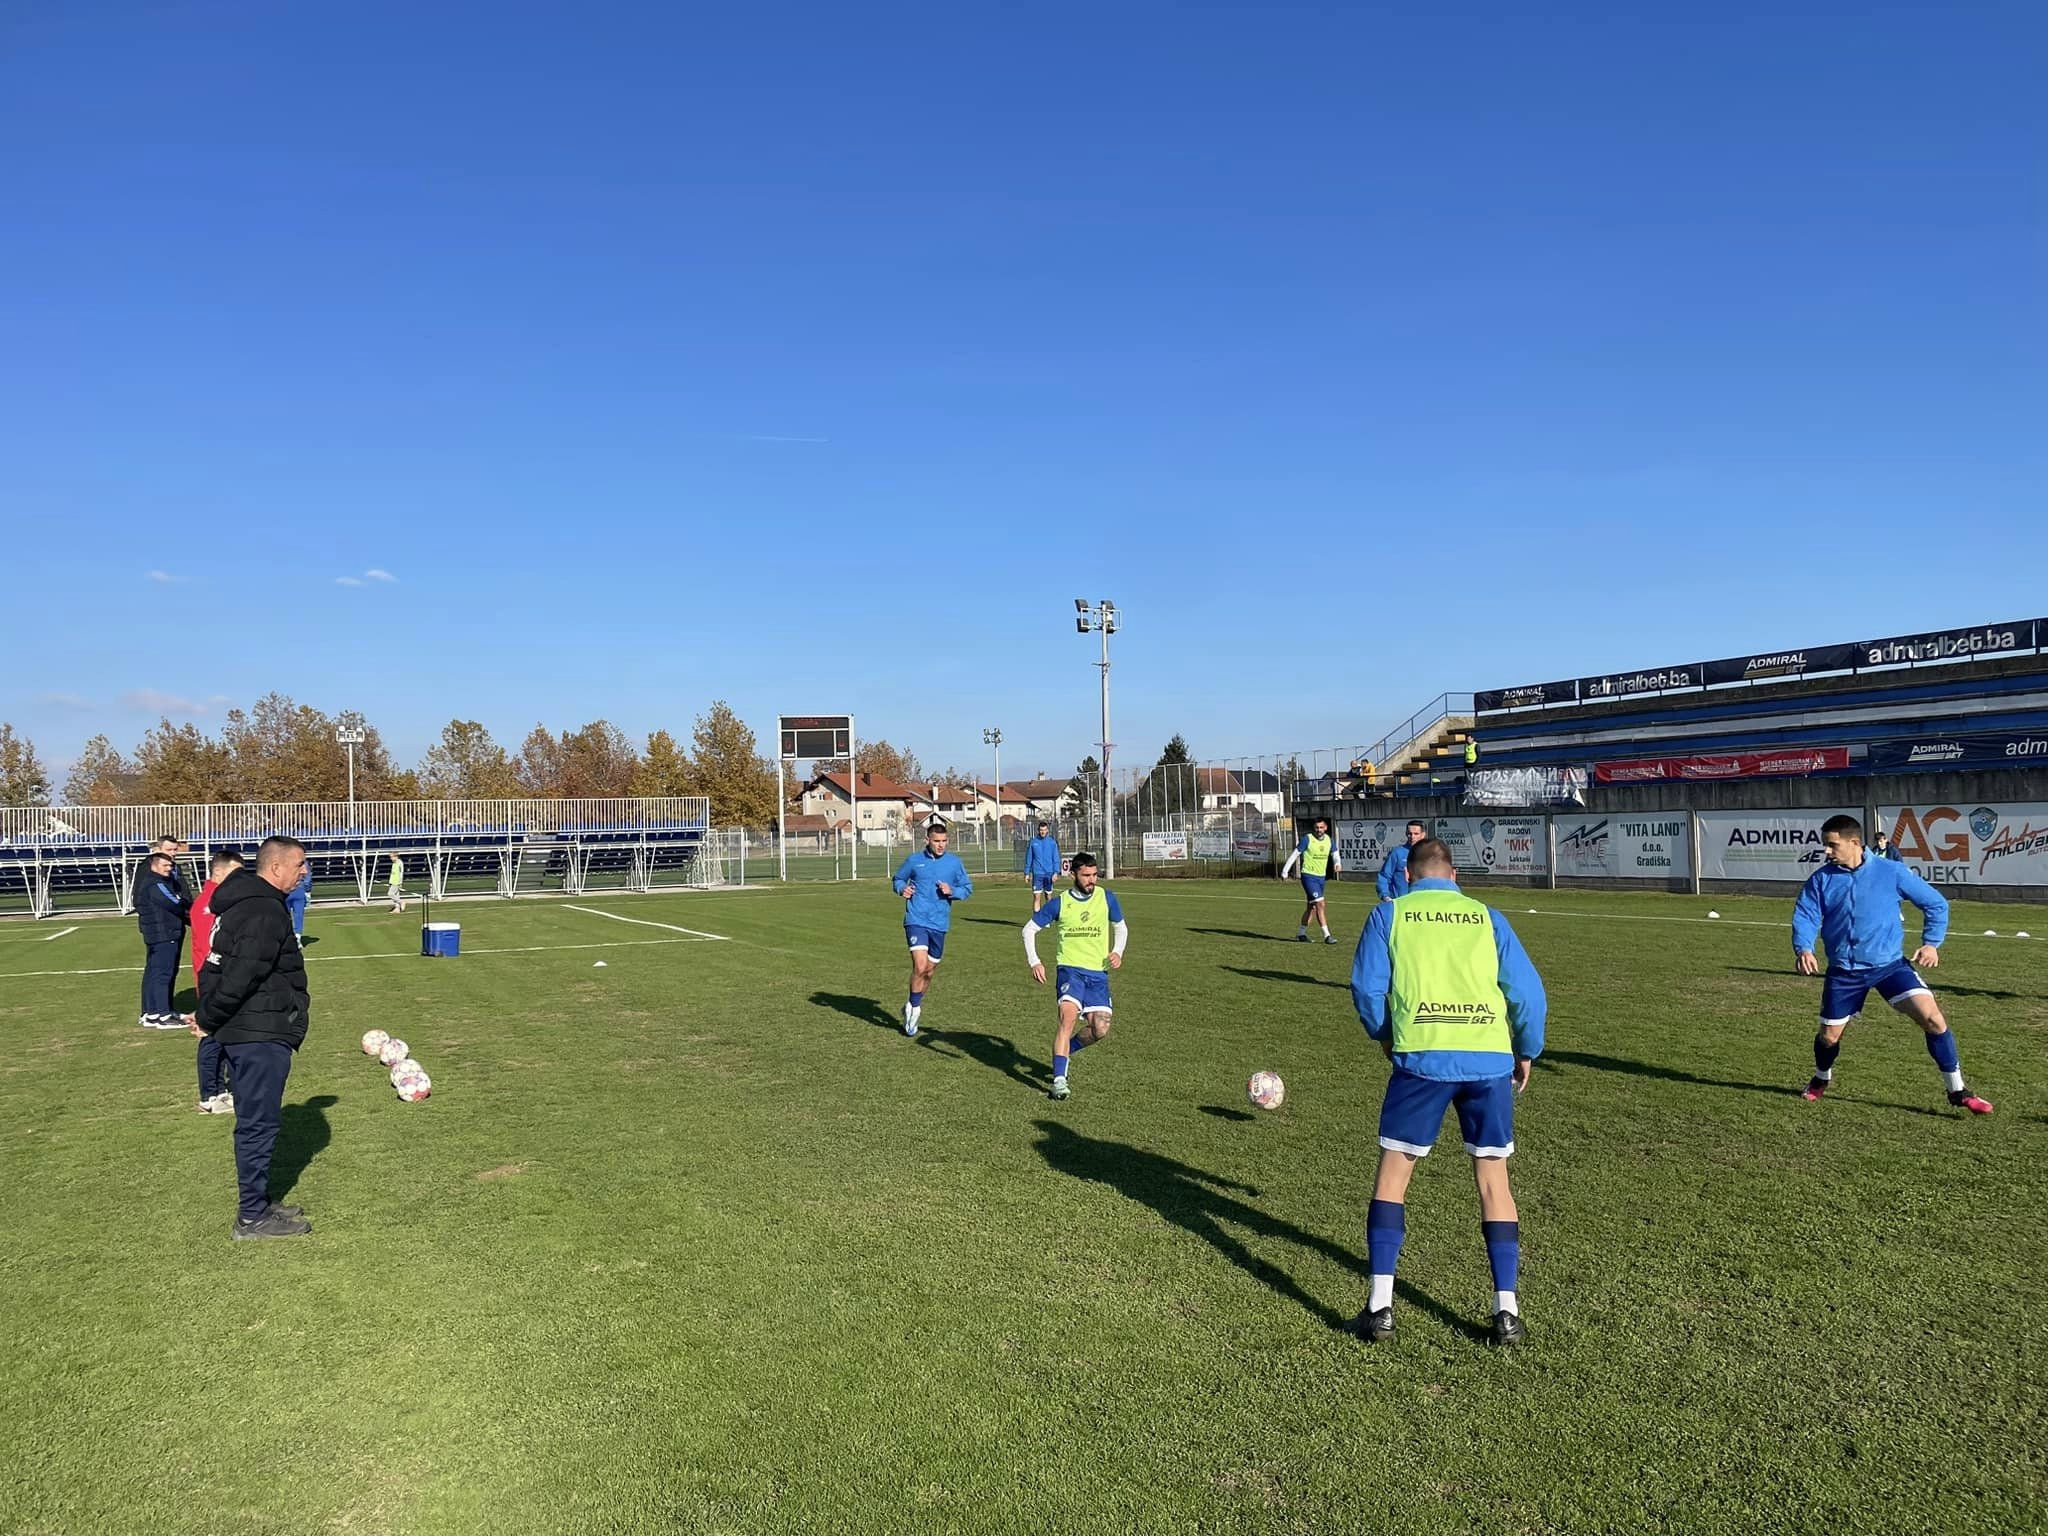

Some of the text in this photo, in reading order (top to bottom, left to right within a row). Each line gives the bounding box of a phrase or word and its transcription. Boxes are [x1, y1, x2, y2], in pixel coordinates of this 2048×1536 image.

[1868, 629, 2015, 664] admiralbet.ba
[1746, 652, 1807, 670] ADMIRAL
[1785, 664, 1807, 674] BET
[1589, 670, 1690, 696] admiralbet.ba
[1911, 742, 1964, 754] ADMIRAL
[2006, 738, 2048, 755] adm
[1620, 822, 1686, 837] "VITA LAND"
[1891, 806, 1970, 862] AG
[1341, 839, 1377, 849] INTER
[1728, 828, 1822, 846] ADMIRA
[1504, 839, 1535, 851] "MK"
[1642, 842, 1664, 852] d.o.o.
[1340, 849, 1380, 860] ENERGY
[1636, 856, 1671, 867] Gradiška
[1909, 866, 1970, 882] OJEKT
[1405, 911, 1484, 925] FK LAKTAŠI
[1417, 1001, 1495, 1015] ADMIRAL
[1470, 1016, 1496, 1025] BET
